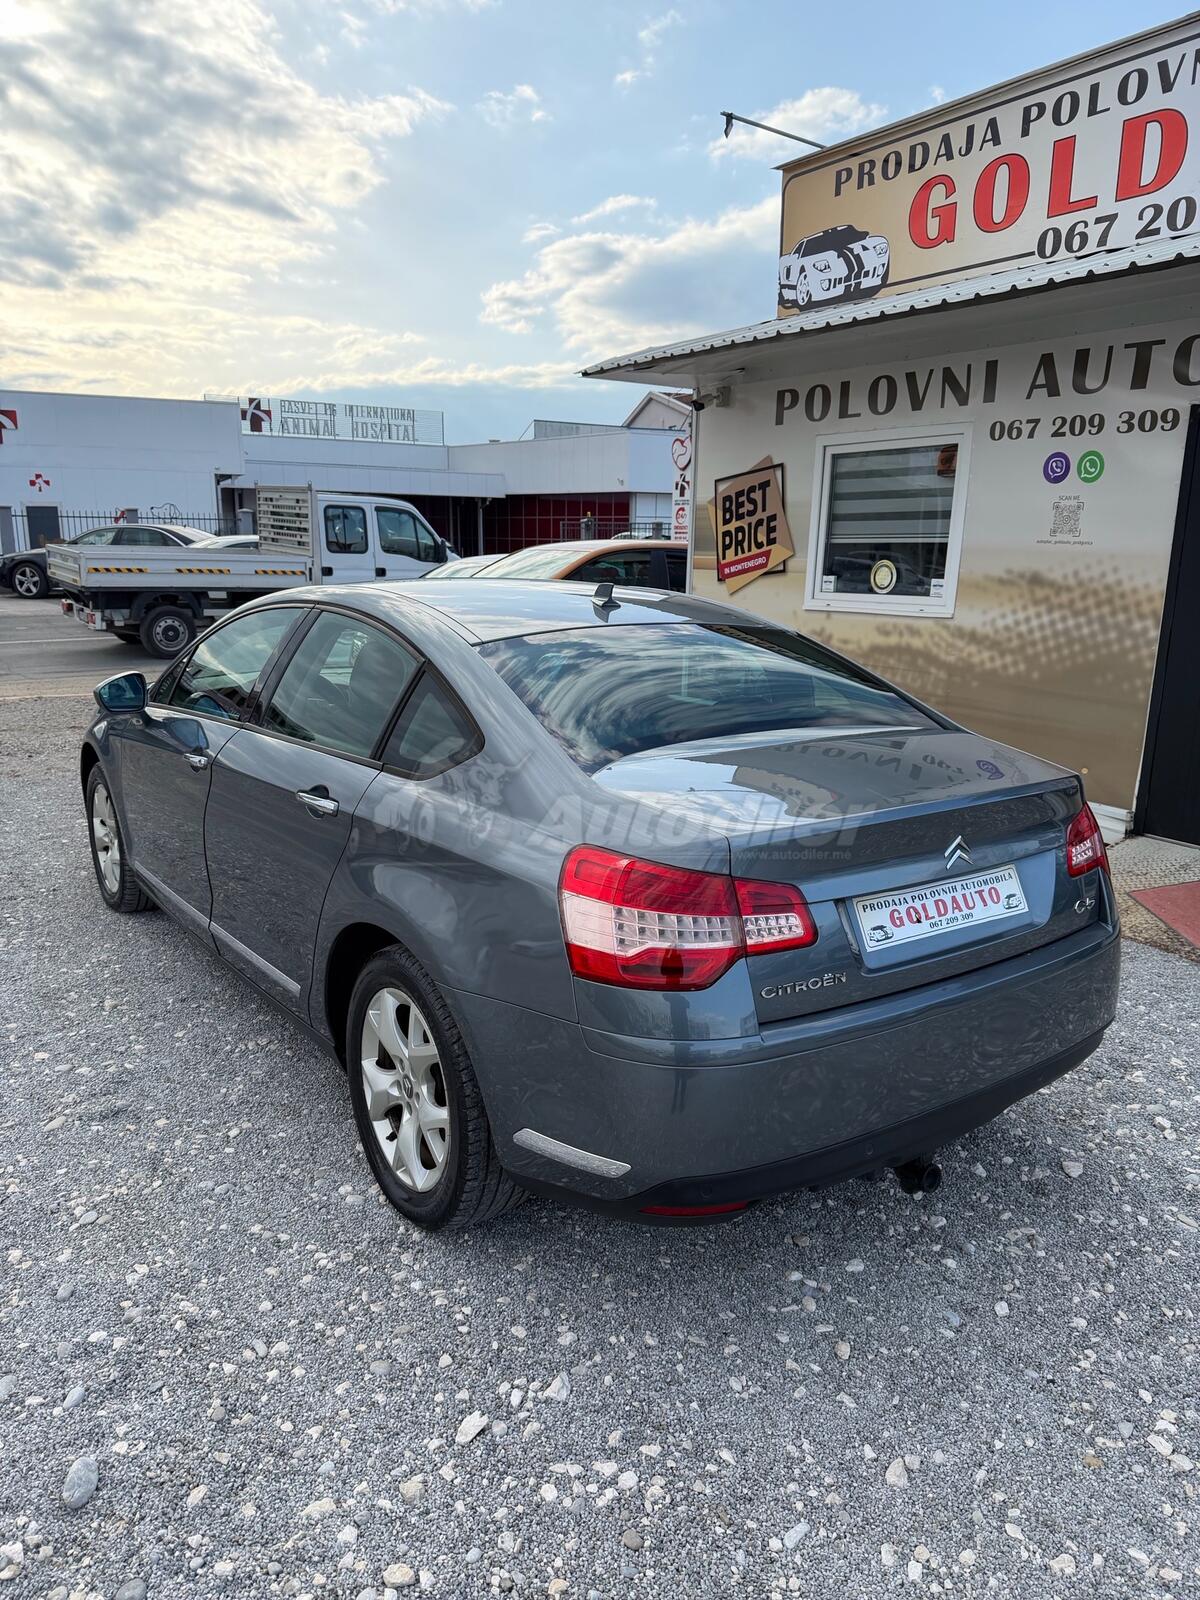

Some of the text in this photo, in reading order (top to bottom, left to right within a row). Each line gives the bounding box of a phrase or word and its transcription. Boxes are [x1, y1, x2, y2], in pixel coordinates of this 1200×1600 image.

[834, 116, 1001, 197] PRODAJA
[908, 108, 1189, 249] GOLD
[1036, 212, 1119, 260] 067
[775, 334, 1200, 425] POLOVNI AUTO
[281, 417, 419, 442] ANIMAL HOSPITAL
[345, 404, 417, 422] INTERNATIONAL
[989, 408, 1180, 441] 067 209 309
[722, 479, 771, 526] BEST
[722, 513, 777, 560] PRICE
[730, 556, 767, 573] MONTENEGRO
[862, 872, 1013, 913] PRODAJA POLOVNIH AUTOMOBILA
[889, 886, 1001, 928] GOLDAUTO
[1075, 897, 1095, 914] C5
[929, 912, 974, 929] 067 209 309
